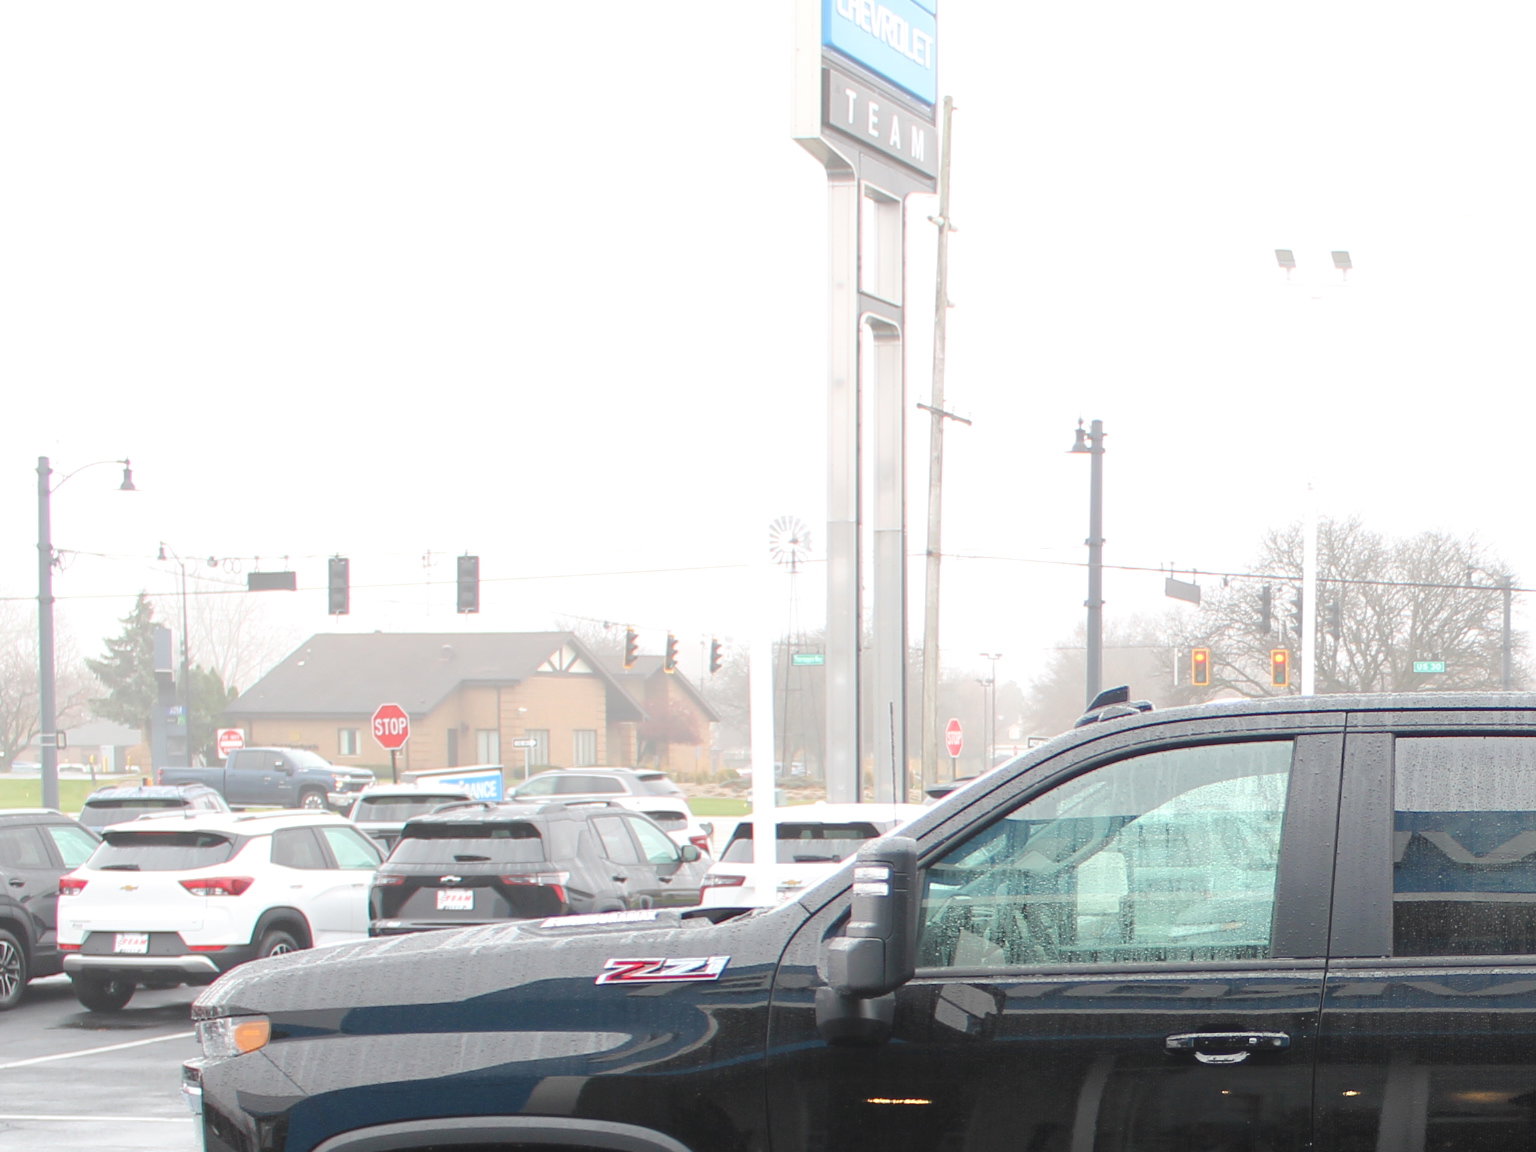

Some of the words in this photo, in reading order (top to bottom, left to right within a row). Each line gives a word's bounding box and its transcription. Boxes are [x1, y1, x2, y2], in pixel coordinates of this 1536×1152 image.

[836, 0, 933, 70] CHEVROLET
[845, 87, 925, 162] TEAM
[375, 717, 407, 736] STOP
[595, 956, 731, 985] Z71
